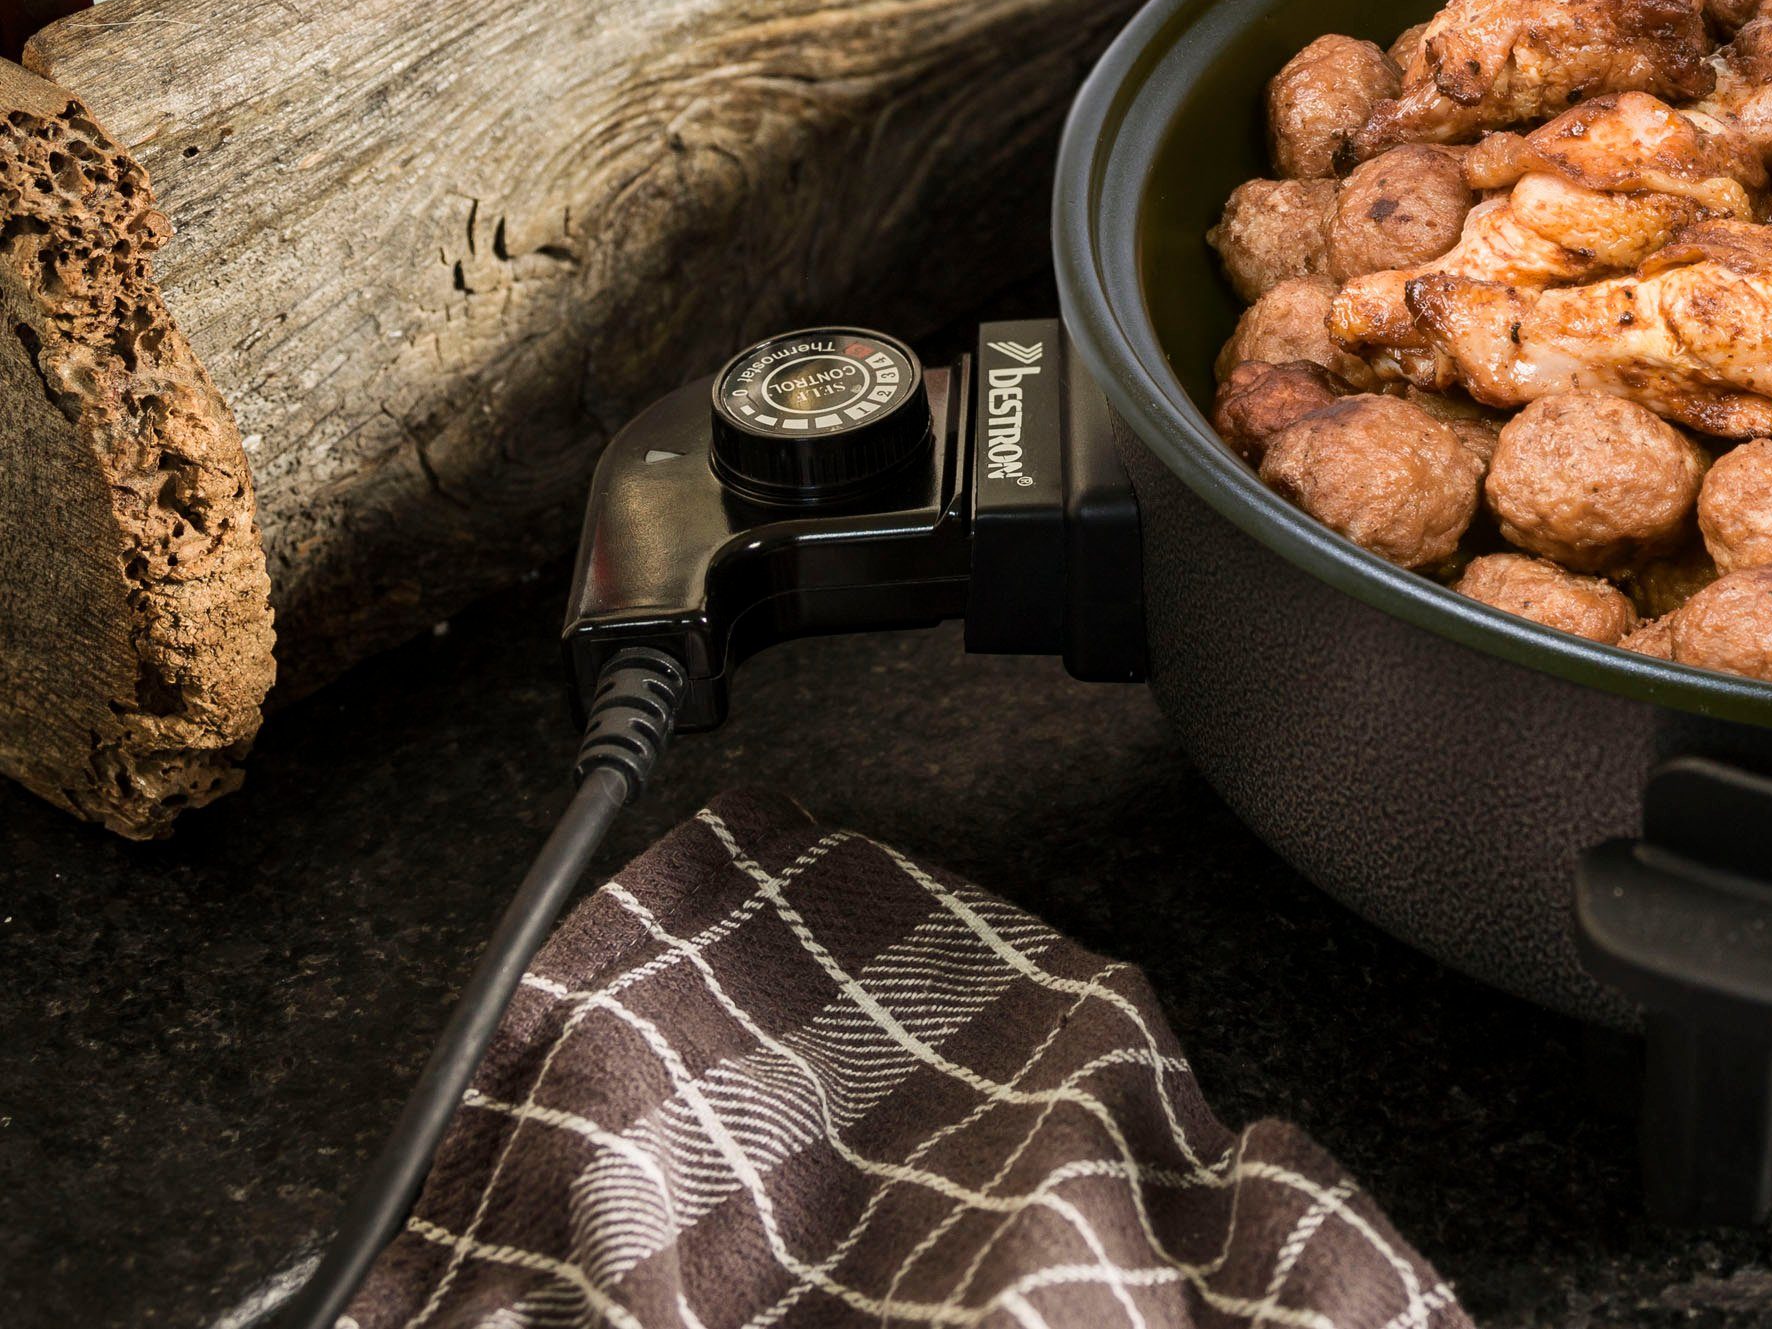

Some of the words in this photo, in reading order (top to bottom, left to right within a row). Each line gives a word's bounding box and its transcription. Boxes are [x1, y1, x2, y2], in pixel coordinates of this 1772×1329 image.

[737, 341, 836, 383] Thermostat
[769, 365, 856, 393] CONTROL
[796, 381, 846, 402] SELF
